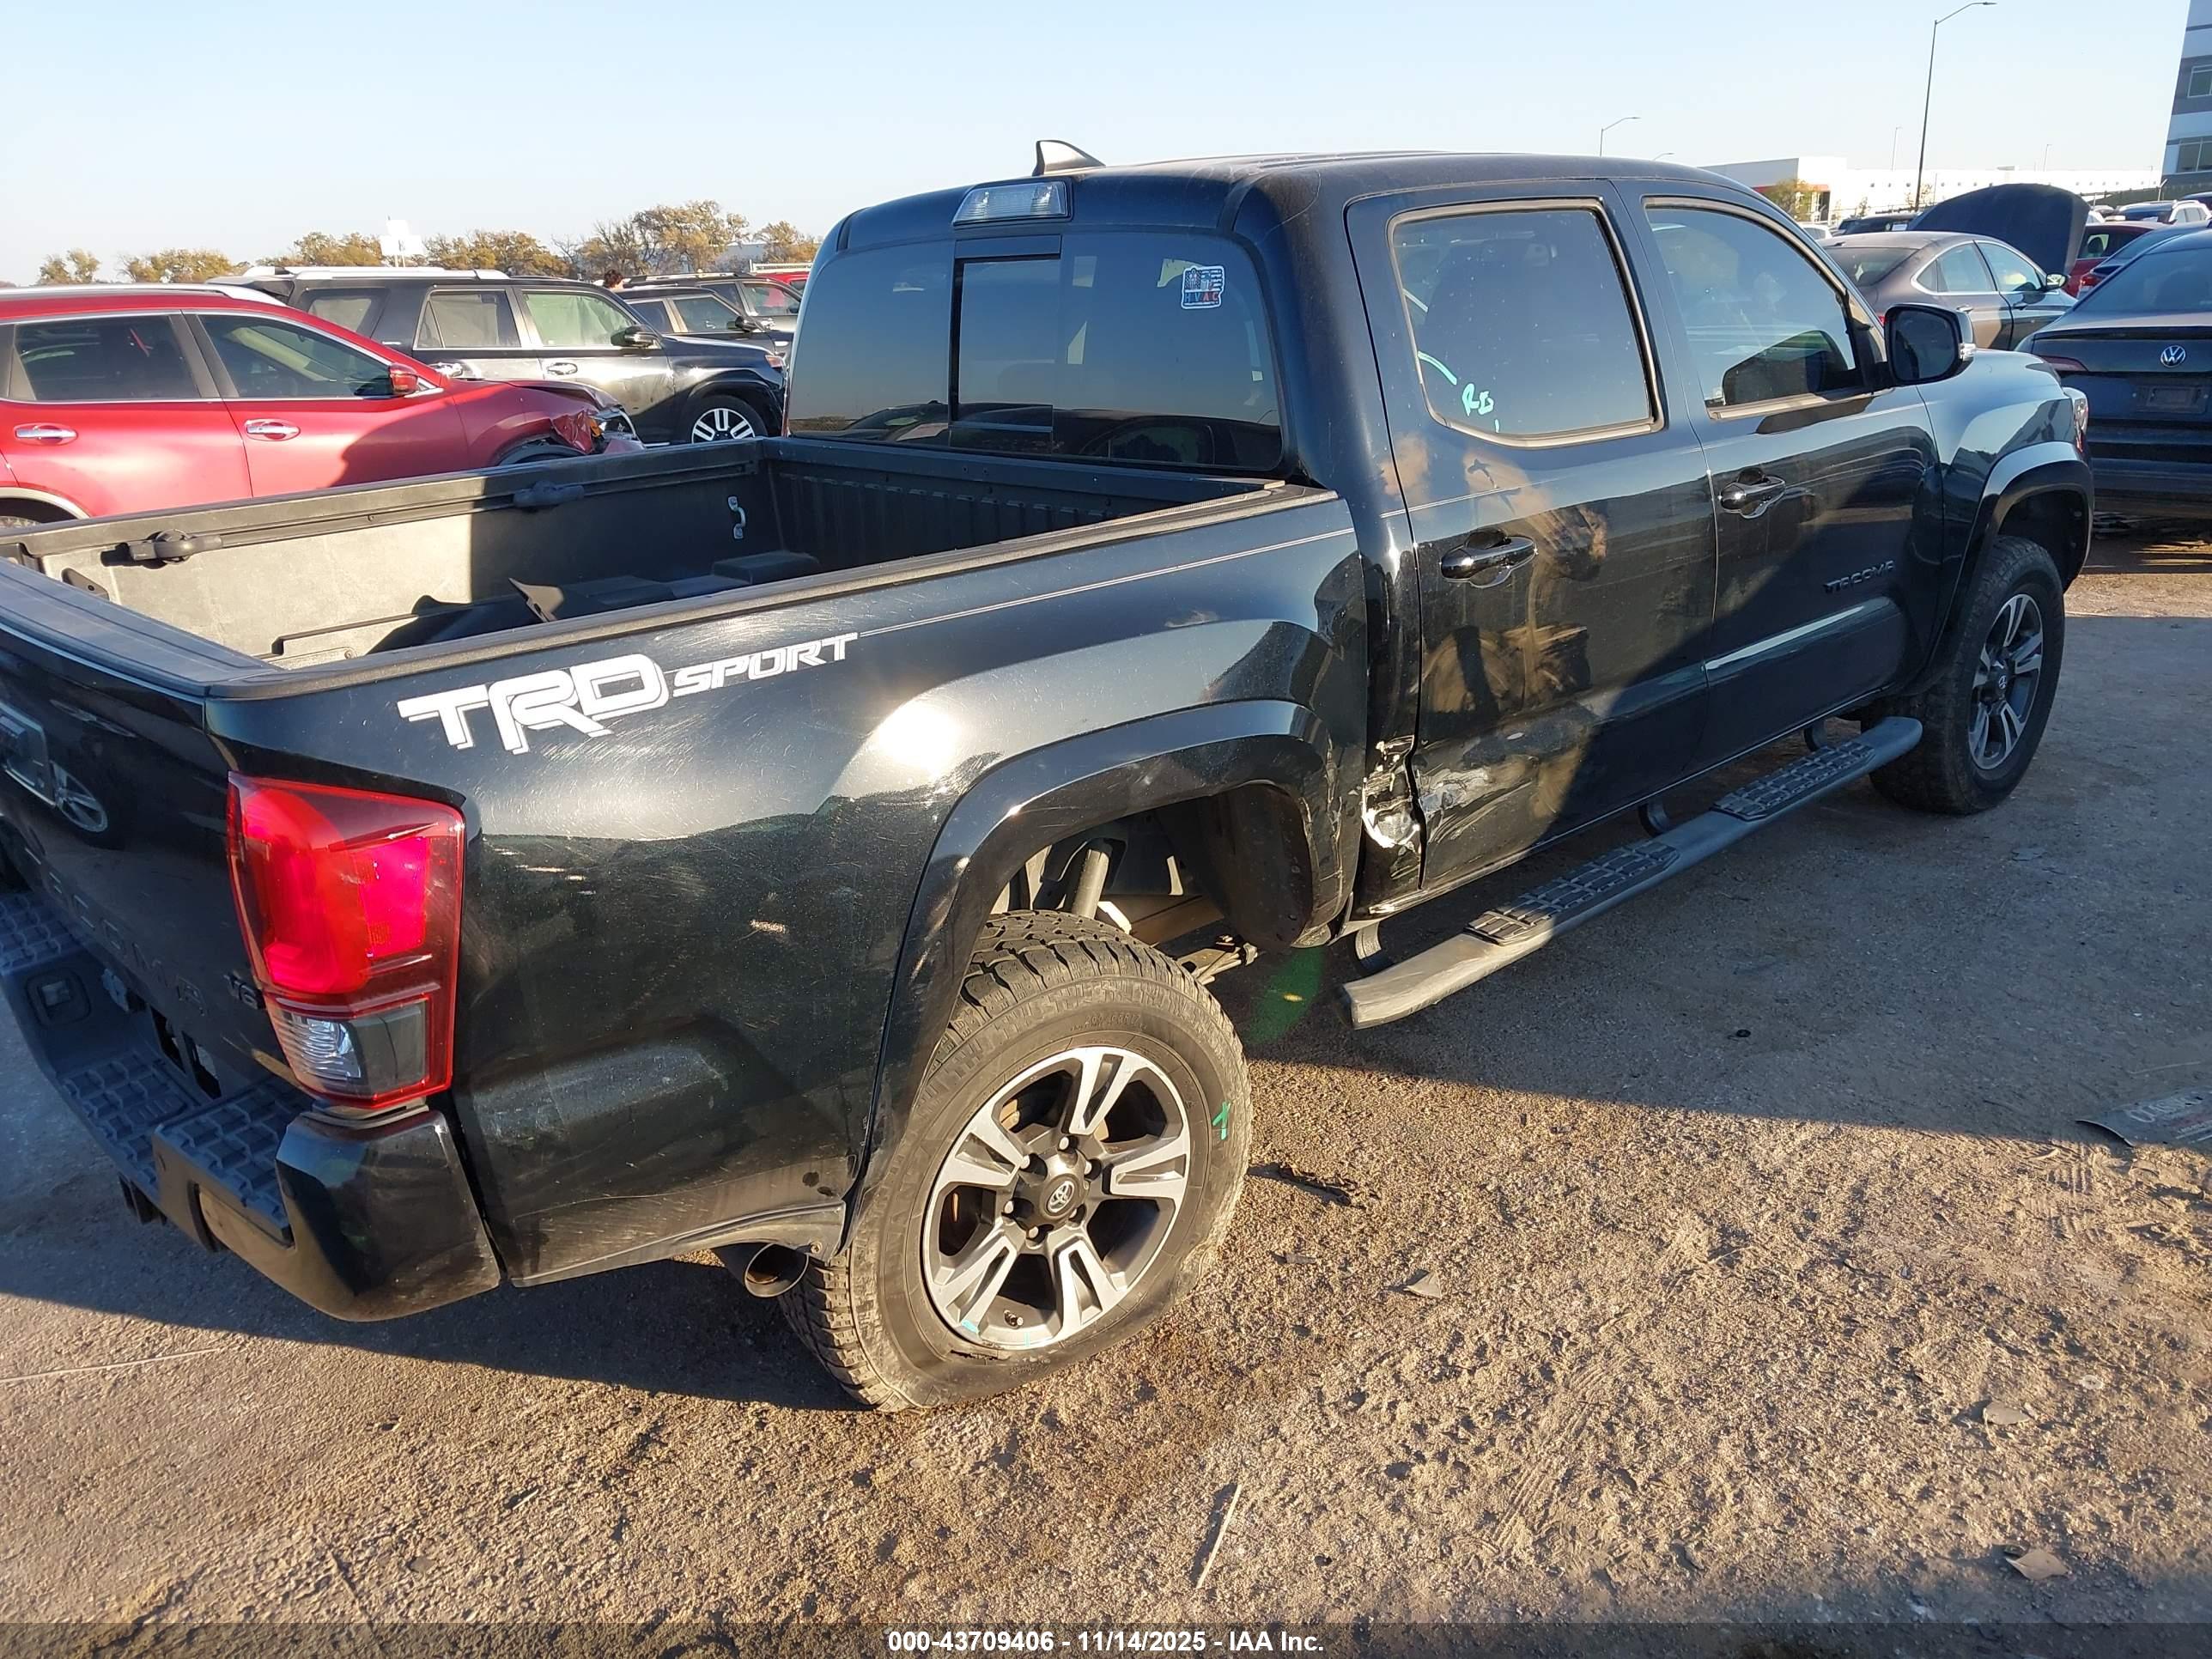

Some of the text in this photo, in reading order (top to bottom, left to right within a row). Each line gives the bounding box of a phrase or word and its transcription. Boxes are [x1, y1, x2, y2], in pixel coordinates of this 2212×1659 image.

[1185, 291, 1218, 302] HVAC
[397, 632, 858, 755] TRD SPORT
